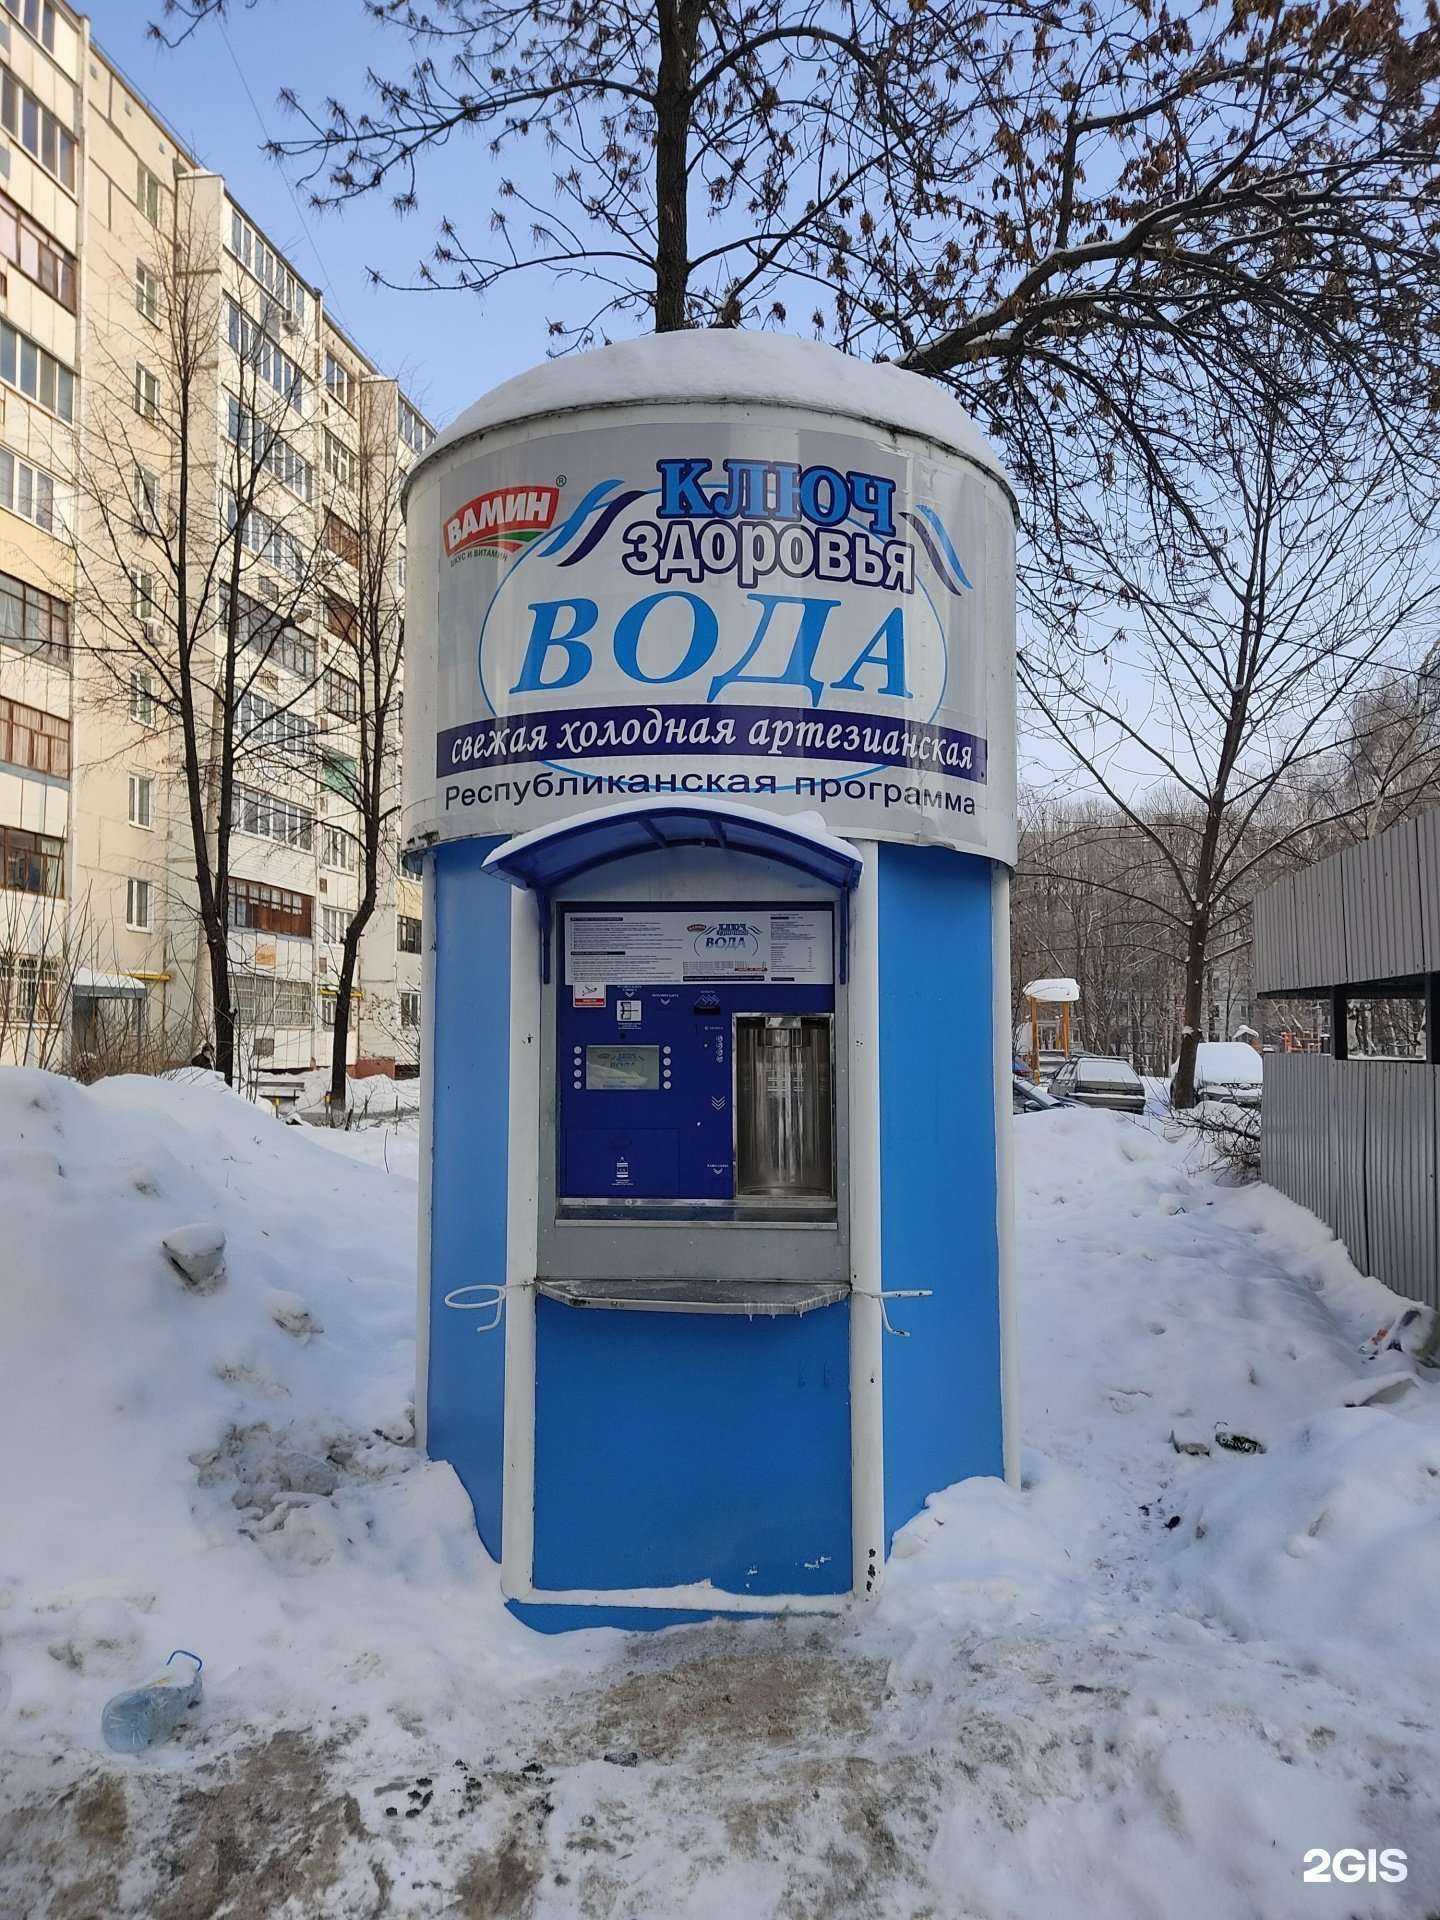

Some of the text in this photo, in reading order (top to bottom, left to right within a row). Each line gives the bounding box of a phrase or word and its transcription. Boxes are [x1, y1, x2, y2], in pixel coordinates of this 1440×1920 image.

[447, 491, 551, 550] ВАМИН
[656, 458, 896, 536] КЛЮЧ
[508, 591, 914, 707] ВОДА
[451, 707, 973, 771] свежая холодная артезианская
[445, 771, 976, 816] Республиканская программа
